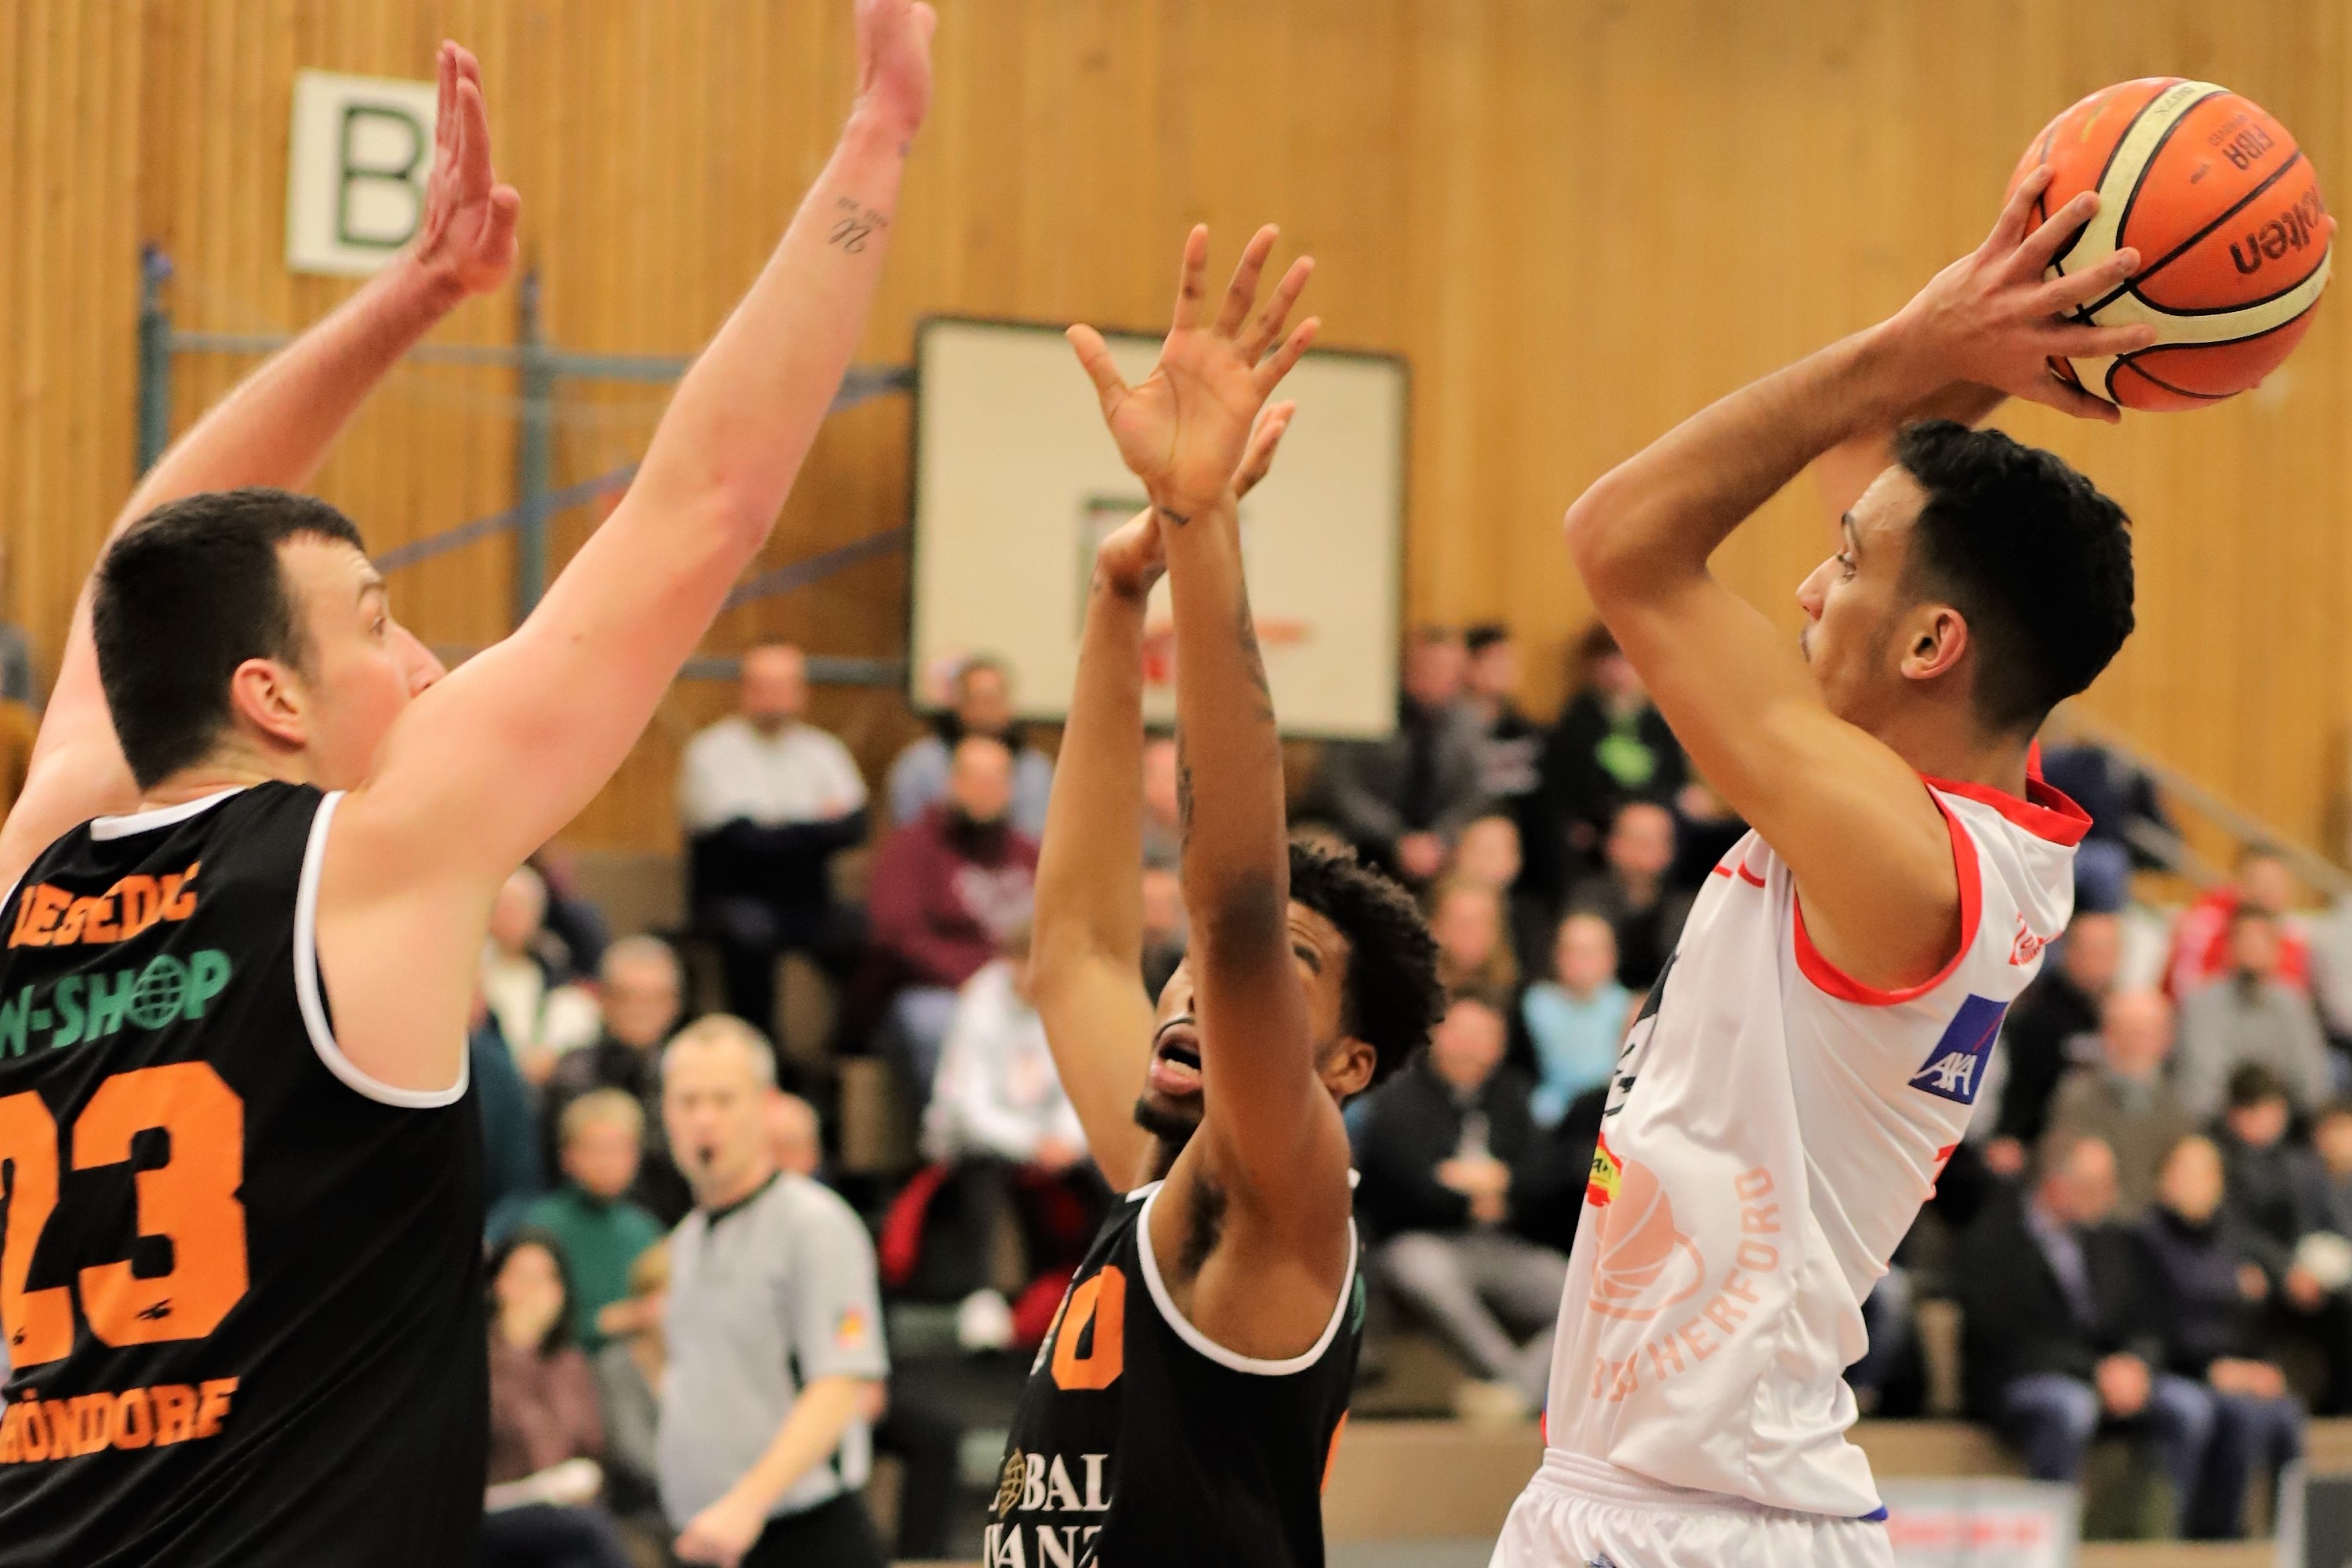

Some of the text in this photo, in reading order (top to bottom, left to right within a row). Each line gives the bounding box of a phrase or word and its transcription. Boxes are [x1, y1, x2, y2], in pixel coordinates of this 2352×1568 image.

[336, 104, 426, 250] B
[2222, 122, 2275, 170] FIBA
[2229, 186, 2325, 274] olten
[1914, 1051, 1977, 1095] AXA
[0, 1061, 249, 1369] 23
[1648, 1167, 1781, 1381] HERFORD
